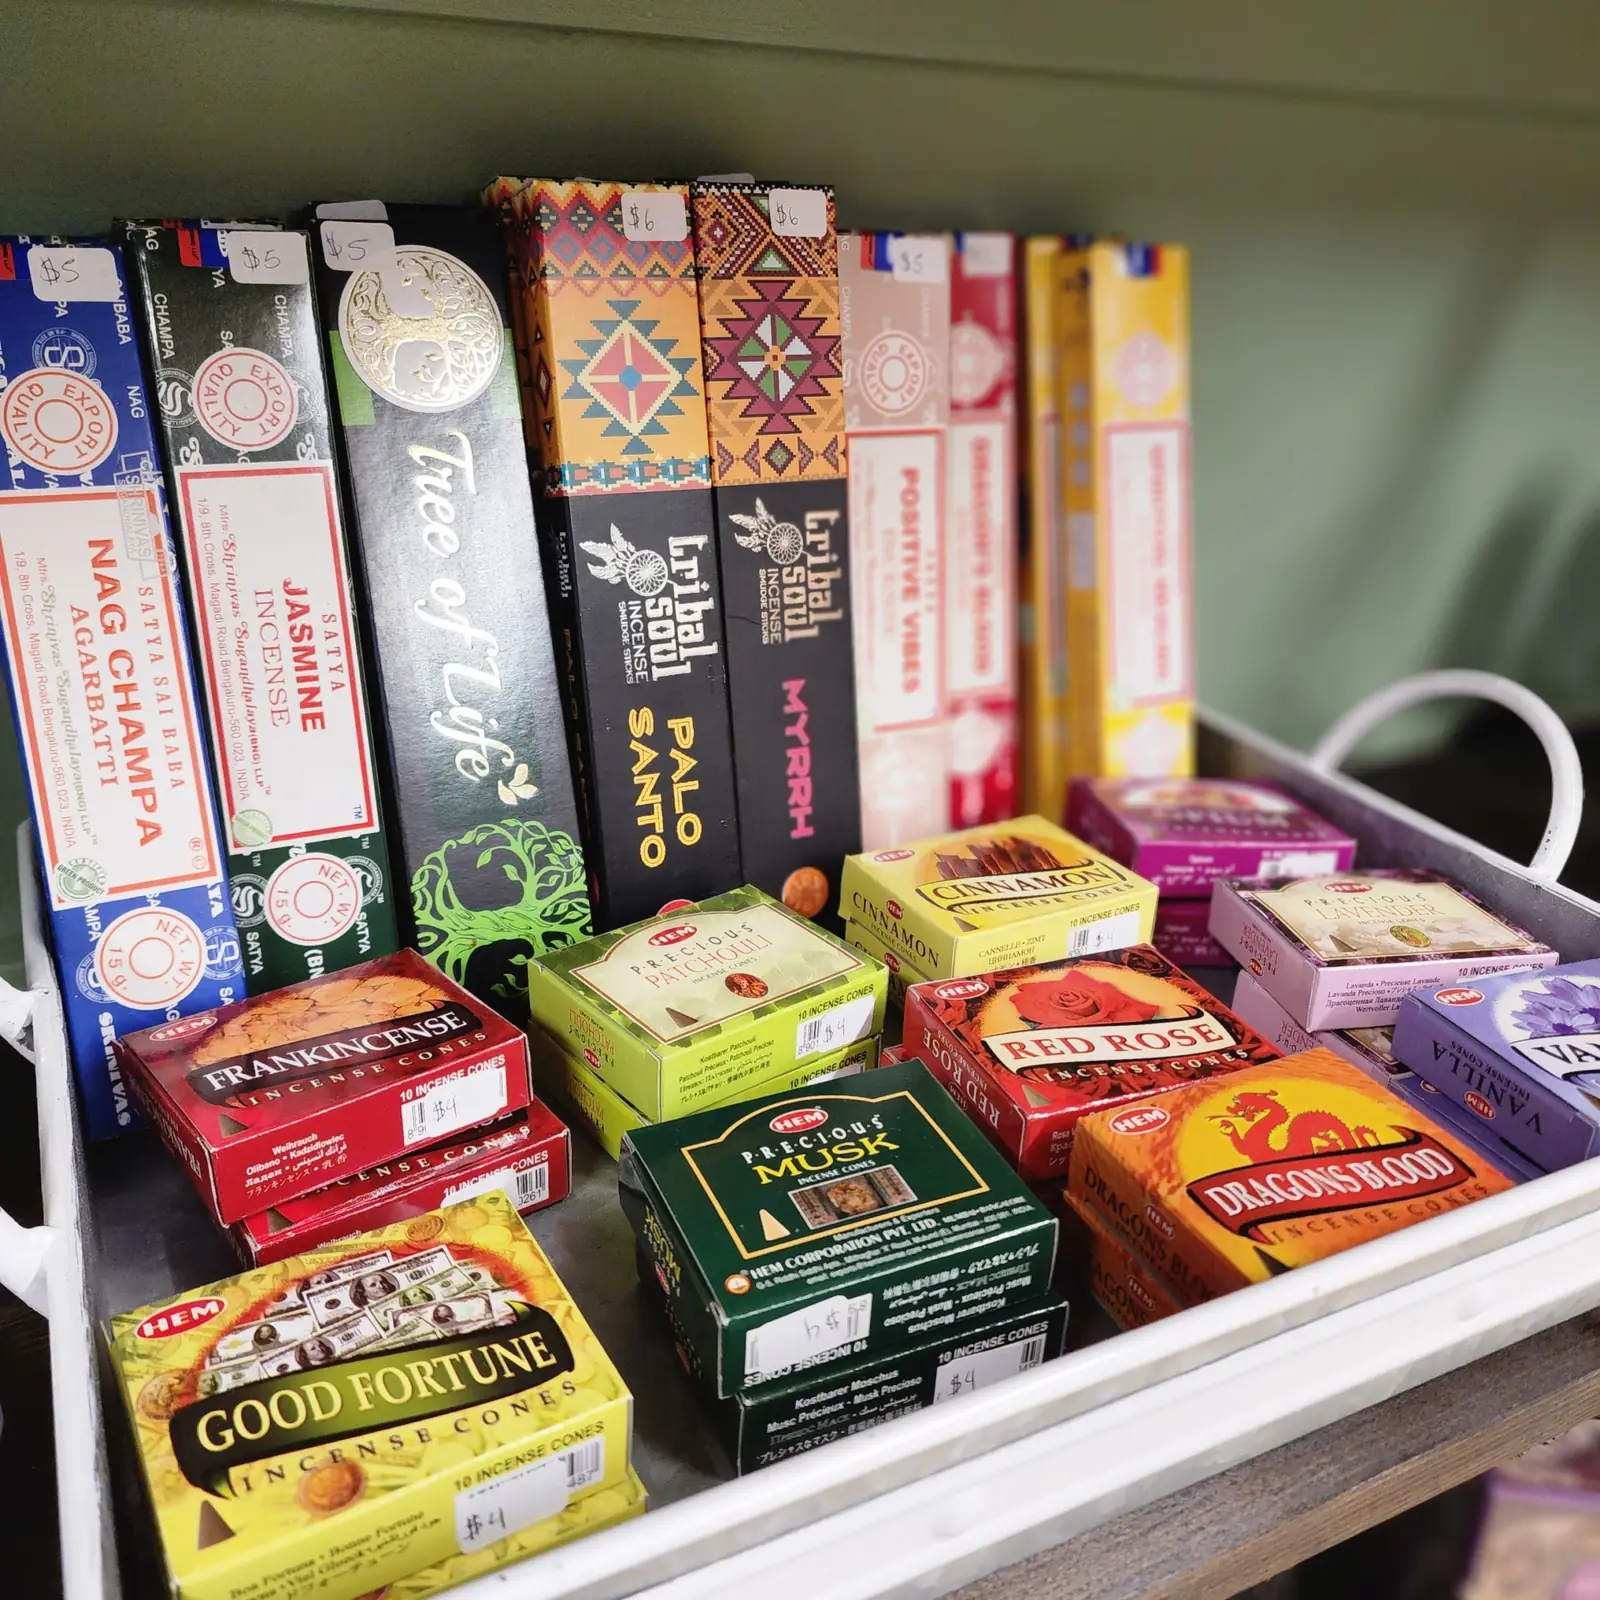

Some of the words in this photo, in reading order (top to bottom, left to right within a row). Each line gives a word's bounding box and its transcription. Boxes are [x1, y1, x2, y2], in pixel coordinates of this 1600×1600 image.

[626, 202, 655, 232] $6
[775, 202, 799, 226] $6
[242, 246, 282, 272] $5
[325, 231, 368, 260] $5
[900, 251, 923, 274] $5
[40, 257, 80, 285] $5
[154, 293, 176, 359] CHAMPA
[274, 294, 293, 359] CHAMPA
[865, 342, 890, 404] QUALITY
[898, 343, 920, 404] EXPORT
[127, 385, 144, 419] NAG
[203, 362, 241, 437] QUALITY
[250, 364, 286, 436] EXPORT
[12, 382, 55, 460] QUALITY
[63, 383, 104, 459] EXPORT
[408, 431, 477, 559] Tree
[899, 466, 921, 602] POSITIVE
[205, 540, 216, 578] Cross,
[221, 533, 241, 618] Shrinivas
[804, 509, 844, 622] tribal
[19, 574, 30, 592] 8th
[210, 583, 222, 620] Magadi
[667, 534, 719, 657] tribal
[758, 569, 768, 611] SMUDGE
[23, 594, 35, 630] Cross,
[41, 584, 62, 667] Shrinivas
[138, 586, 164, 663] SATYA
[414, 578, 499, 657] of
[617, 601, 631, 645] SMUDGE
[767, 568, 783, 645] INCENSE
[628, 600, 649, 684] INCENSE
[760, 612, 770, 645] STICKS
[29, 632, 45, 672] Magadi
[254, 589, 291, 728] INCENSE
[283, 577, 326, 733] JASMINE
[322, 613, 346, 693] SATYA
[623, 646, 634, 685] STICKS
[901, 612, 922, 693] VIBES
[70, 604, 119, 787] AGARBATTI
[88, 539, 128, 635] NAG
[108, 649, 164, 846] CHAMPA
[154, 677, 174, 715] SAI
[430, 656, 515, 781] Life
[163, 728, 185, 789] BABA
[782, 678, 815, 840] MYRRH
[236, 768, 249, 801] INDIA
[628, 706, 667, 868] SANTO
[667, 716, 703, 847] PALO
[62, 815, 77, 849] INDIA
[932, 867, 1112, 901] CINNAMON
[971, 895, 1064, 915] INCENSE
[1072, 883, 1135, 902] CONES
[853, 892, 939, 968] CINNAMON
[887, 902, 903, 918] HEM
[1079, 910, 1113, 927] INCENSE
[1114, 902, 1140, 917] CONES
[1316, 904, 1445, 920] LAVENDER
[246, 931, 264, 975] SATYA
[356, 911, 371, 954] SATYA
[650, 927, 696, 946] HEM
[979, 939, 1021, 958] CANNELLE
[644, 934, 774, 989] PATCHOULI
[692, 966, 727, 985] INCENSE
[728, 956, 758, 972] CONES
[1458, 968, 1468, 977] 10
[798, 1010, 807, 1021] 10
[808, 995, 845, 1018] INCENSE
[846, 984, 875, 1001] CONES
[938, 983, 985, 999] HEM
[1327, 990, 1356, 999] Lavanda
[1357, 988, 1386, 997] Precioso
[1356, 1004, 1389, 1013] Wertvoller
[1438, 989, 1482, 1005] HEM
[153, 1017, 216, 1041] HEM
[700, 1046, 729, 1064] Kostbarer
[729, 1035, 758, 1051] Patchouli
[823, 1017, 848, 1043] $4
[1000, 1034, 1096, 1061] RED
[1100, 1022, 1224, 1053] ROSE
[203, 1010, 468, 1091] FRANKINCENSE
[249, 1064, 386, 1107] INCENSE
[399, 1032, 487, 1067] CONES
[679, 1068, 704, 1083] Patchouli
[729, 1048, 754, 1063] Patchouli
[789, 1078, 799, 1088] 10
[800, 1063, 838, 1086] INCENSE
[839, 1050, 867, 1069] CONES
[922, 1027, 972, 1082] ROSE
[1044, 1061, 1162, 1083] INCENSE
[1171, 1048, 1250, 1071] CONES
[400, 1091, 413, 1102] 10
[415, 1069, 464, 1096] INCENSE
[467, 1055, 506, 1077] CONES
[1433, 1039, 1543, 1137] VANILLA
[432, 1096, 458, 1122] $4
[773, 1110, 825, 1131] HEM
[966, 1077, 1002, 1131] RED
[1113, 1109, 1165, 1134] HEM
[1467, 1093, 1495, 1119] HEM
[272, 1133, 318, 1156] Weihrauch
[444, 1125, 531, 1162] CONES
[1052, 1129, 1070, 1142] Rosa
[246, 1159, 281, 1175] Olibano
[443, 1187, 456, 1199] 10
[510, 1150, 550, 1174] CONES
[751, 1132, 900, 1185] MUSK
[797, 1167, 839, 1186] INCENSE
[841, 1158, 876, 1177] CONES
[1204, 1162, 1356, 1217] DRAGONS
[1352, 1147, 1456, 1188] BLOOD
[1270, 1208, 1394, 1241] INCENSE
[1406, 1181, 1490, 1216] CONES
[750, 1261, 783, 1280] HEM
[785, 1235, 882, 1269] CORPORATION
[883, 1225, 911, 1243] PVT.
[913, 1215, 942, 1234] LTD.
[142, 1299, 223, 1338] HEM
[956, 1297, 1007, 1321] Kostbarer
[797, 1343, 852, 1371] INCENSE
[938, 1351, 951, 1364] 10
[954, 1333, 1006, 1361] INCENSE
[1007, 1321, 1049, 1344] CONES
[196, 1372, 344, 1454] GOOD
[348, 1331, 557, 1412] FORTUNE
[795, 1385, 850, 1411] Kostbarer
[851, 1369, 899, 1392] Moschus
[949, 1370, 977, 1396] $4
[767, 1415, 796, 1434] Musc
[798, 1400, 846, 1423] Précieux
[853, 1389, 880, 1406] Musk
[881, 1375, 923, 1398] Precioso
[241, 1428, 432, 1493] INCENSE
[454, 1379, 577, 1434] CONES
[454, 1475, 472, 1491] 10
[475, 1442, 546, 1487] INCENSE
[550, 1419, 605, 1452] CONES
[463, 1507, 507, 1541] $4
